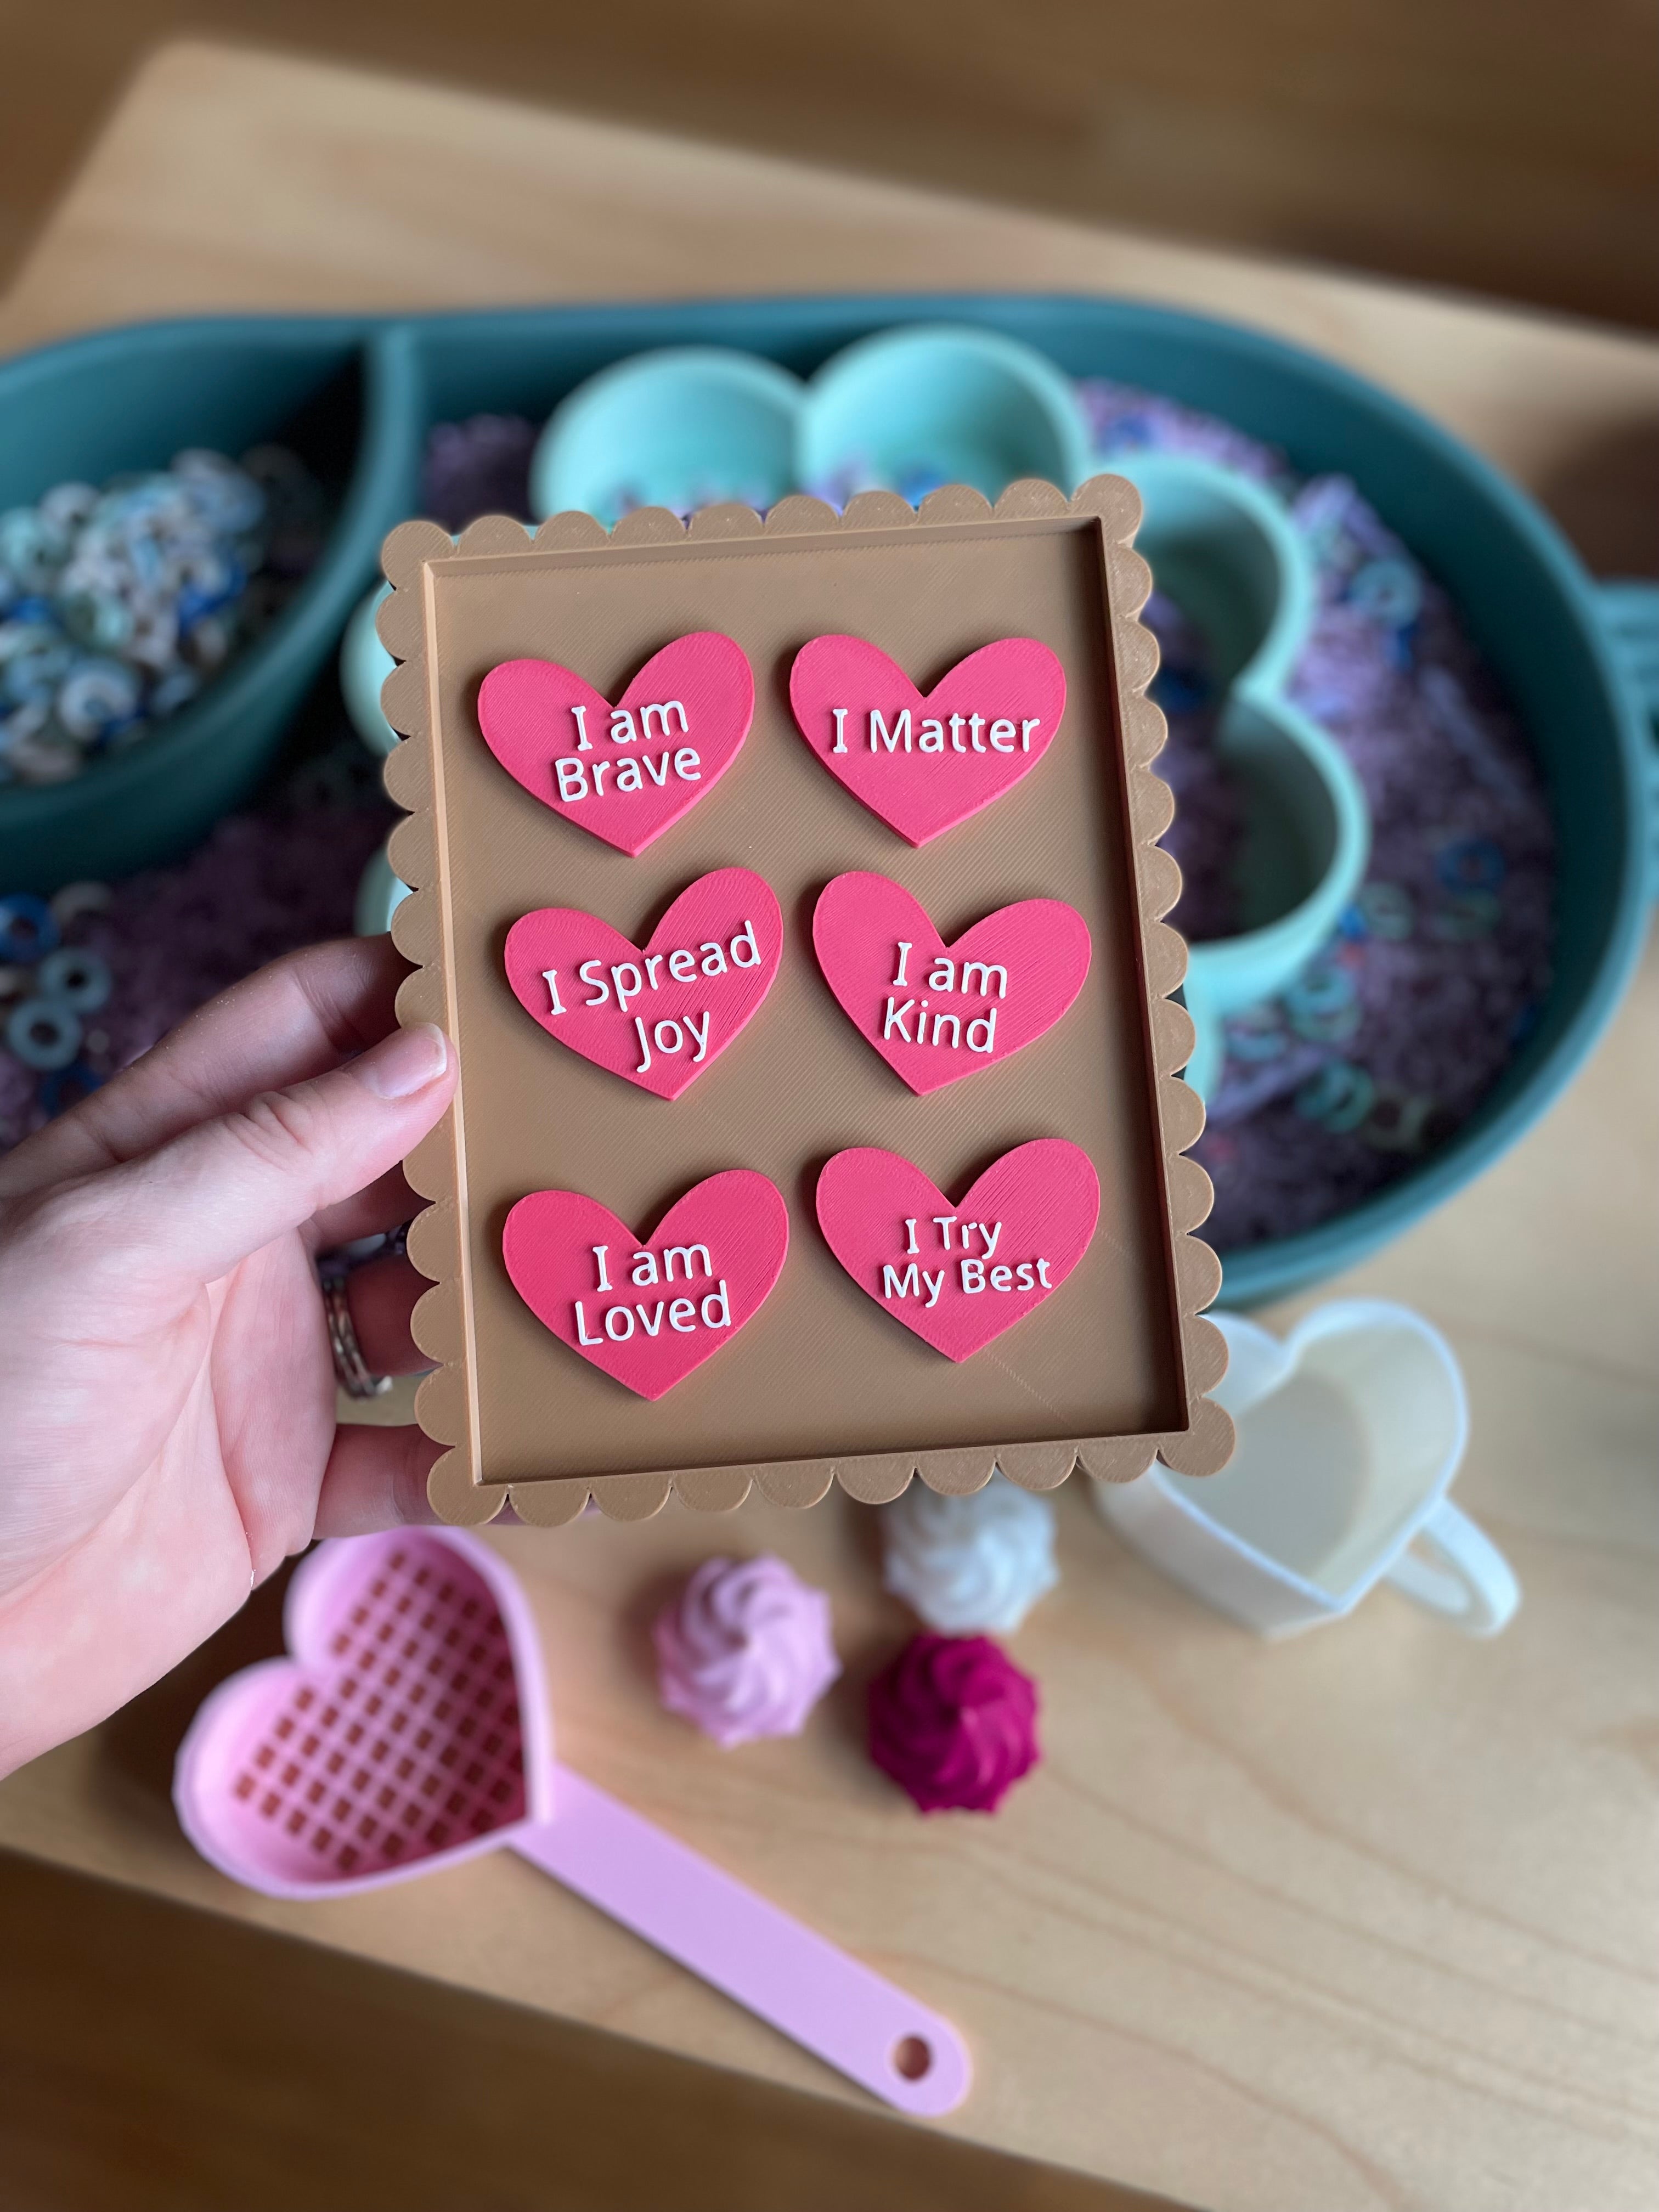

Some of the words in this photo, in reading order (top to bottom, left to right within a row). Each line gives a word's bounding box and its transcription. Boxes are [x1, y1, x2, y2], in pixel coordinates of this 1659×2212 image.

[571, 705, 593, 752] I
[610, 700, 689, 744] am
[832, 708, 848, 754] I
[870, 709, 1041, 753] Matter
[555, 747, 702, 803] Brave
[542, 969, 567, 1015] I
[579, 919, 761, 1013] Spread
[893, 941, 913, 987] I
[928, 957, 1008, 1000] am
[635, 1011, 710, 1073] Joy
[884, 996, 997, 1054] Kind
[905, 1218, 920, 1255] I
[933, 1216, 1002, 1260] Try
[592, 1245, 613, 1293] I
[632, 1244, 713, 1286] am
[883, 1263, 945, 1308] My
[960, 1258, 1052, 1294] Best
[575, 1279, 731, 1346] Loved
